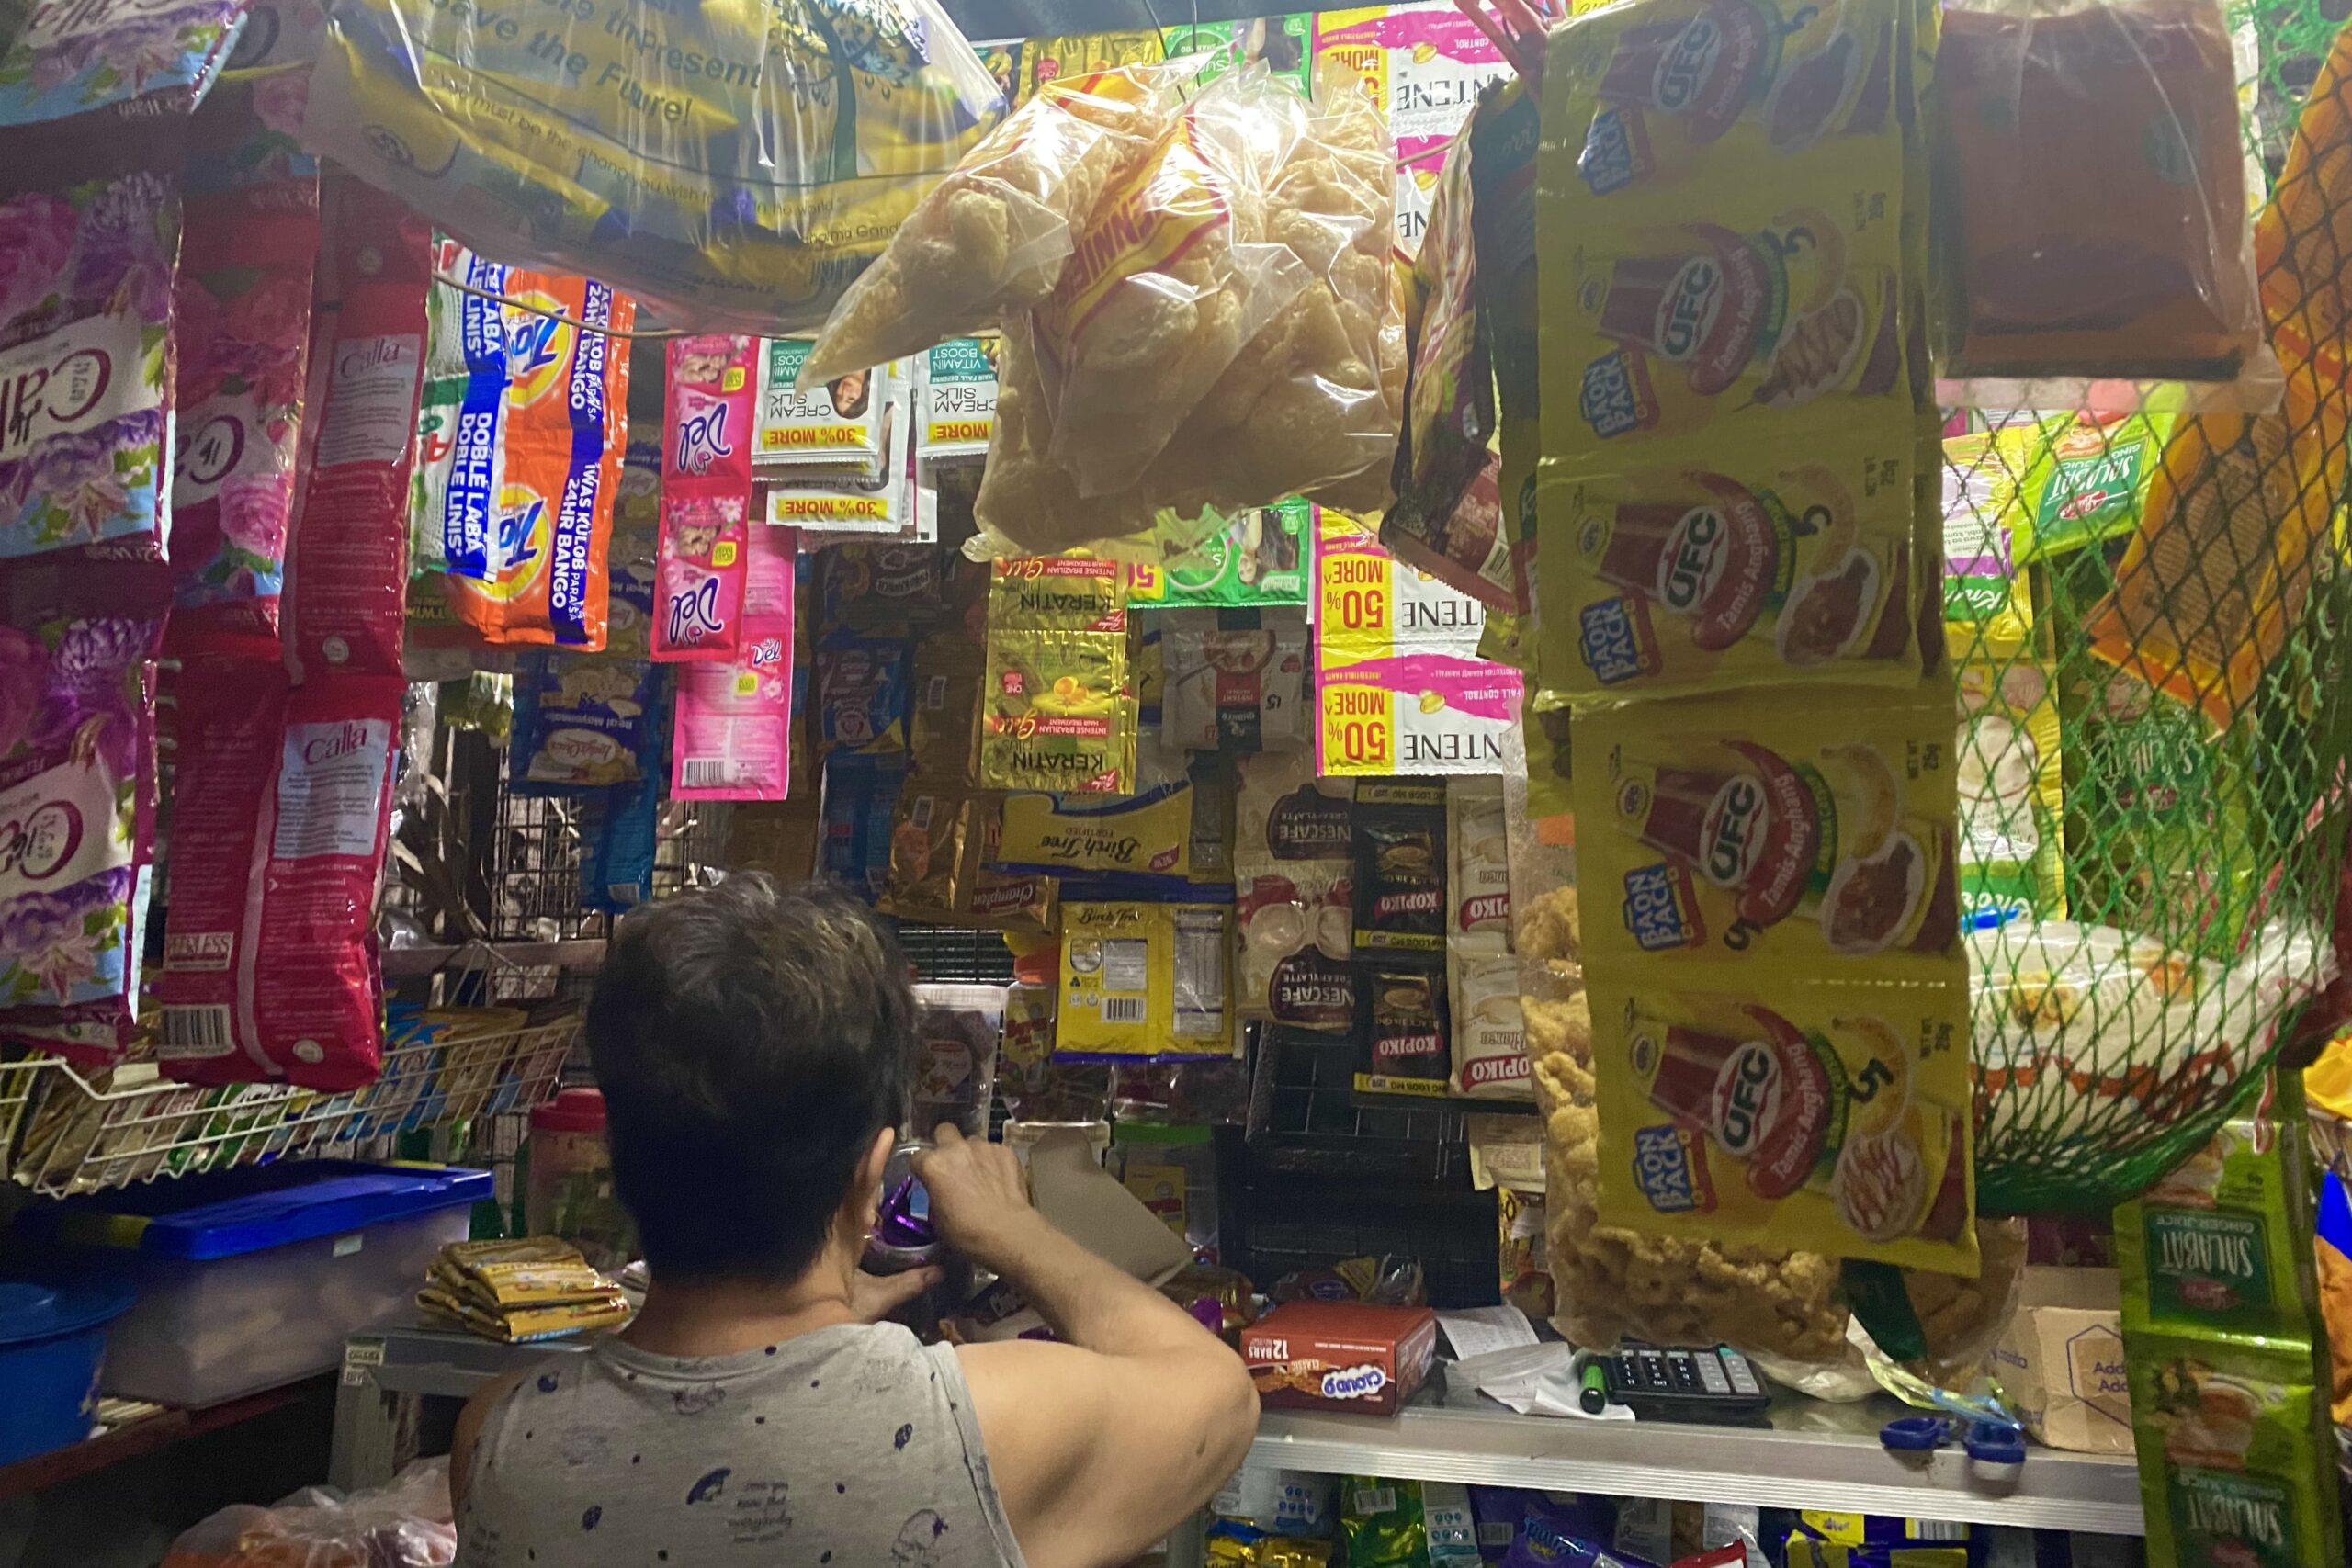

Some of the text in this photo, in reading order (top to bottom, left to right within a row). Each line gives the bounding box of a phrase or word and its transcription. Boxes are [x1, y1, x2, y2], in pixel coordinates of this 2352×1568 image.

[1453, 36, 1489, 49] CONTROL
[1664, 262, 1713, 355] UFC
[571, 337, 591, 410] BANGO
[933, 348, 978, 359] BOOST
[933, 359, 982, 370] VITAMIN
[770, 405, 831, 419] CREAM
[934, 399, 999, 413] CREAM
[935, 388, 977, 400] SILK
[1601, 357, 1635, 430] PACK
[451, 413, 476, 487] DOBLE
[678, 403, 731, 472] Del
[769, 427, 858, 445] 30% MORE
[935, 423, 989, 439] MORE
[463, 412, 492, 554] DOBLE LABA
[784, 501, 877, 515] 30% MORE
[551, 478, 579, 609] 24HR BANGO
[571, 512, 593, 570] KULOB
[1665, 510, 1717, 608] UFC
[1735, 501, 1769, 581] Anghang
[669, 578, 722, 641] Del
[1020, 593, 1111, 610] KERATIN
[1326, 589, 1385, 629] 50%
[1402, 600, 1485, 628] TENE
[752, 640, 783, 665] Del
[1583, 607, 1618, 679] BAON
[1606, 598, 1637, 674] PACK
[1463, 689, 1500, 701] CONTROL
[305, 723, 367, 765] Calla
[1038, 725, 1107, 735] INTENSE BRAZILIAN
[1328, 721, 1386, 761] 50%
[1403, 733, 1503, 761] NTENE
[1012, 752, 1103, 771] KERATIN
[1065, 827, 1114, 838] FORTIFIED
[1709, 781, 1755, 880] UFC
[1774, 773, 1810, 861] Anghang
[1040, 835, 1140, 863] Birch Tree
[1381, 892, 1438, 912] KOPIKO
[1627, 873, 1659, 944] BAON
[1645, 868, 1682, 942] PACK
[1379, 1035, 1437, 1056] KOPIKO
[1472, 1057, 1530, 1081] OPIKO
[1723, 1048, 1770, 1148] UFC
[1637, 1135, 1670, 1208] BAON
[1657, 1130, 1693, 1205] PACK
[2160, 1230, 2254, 1278] SALABAT
[1248, 1339, 1289, 1359] 12 BARS
[1290, 1359, 1320, 1372] CLASSIC
